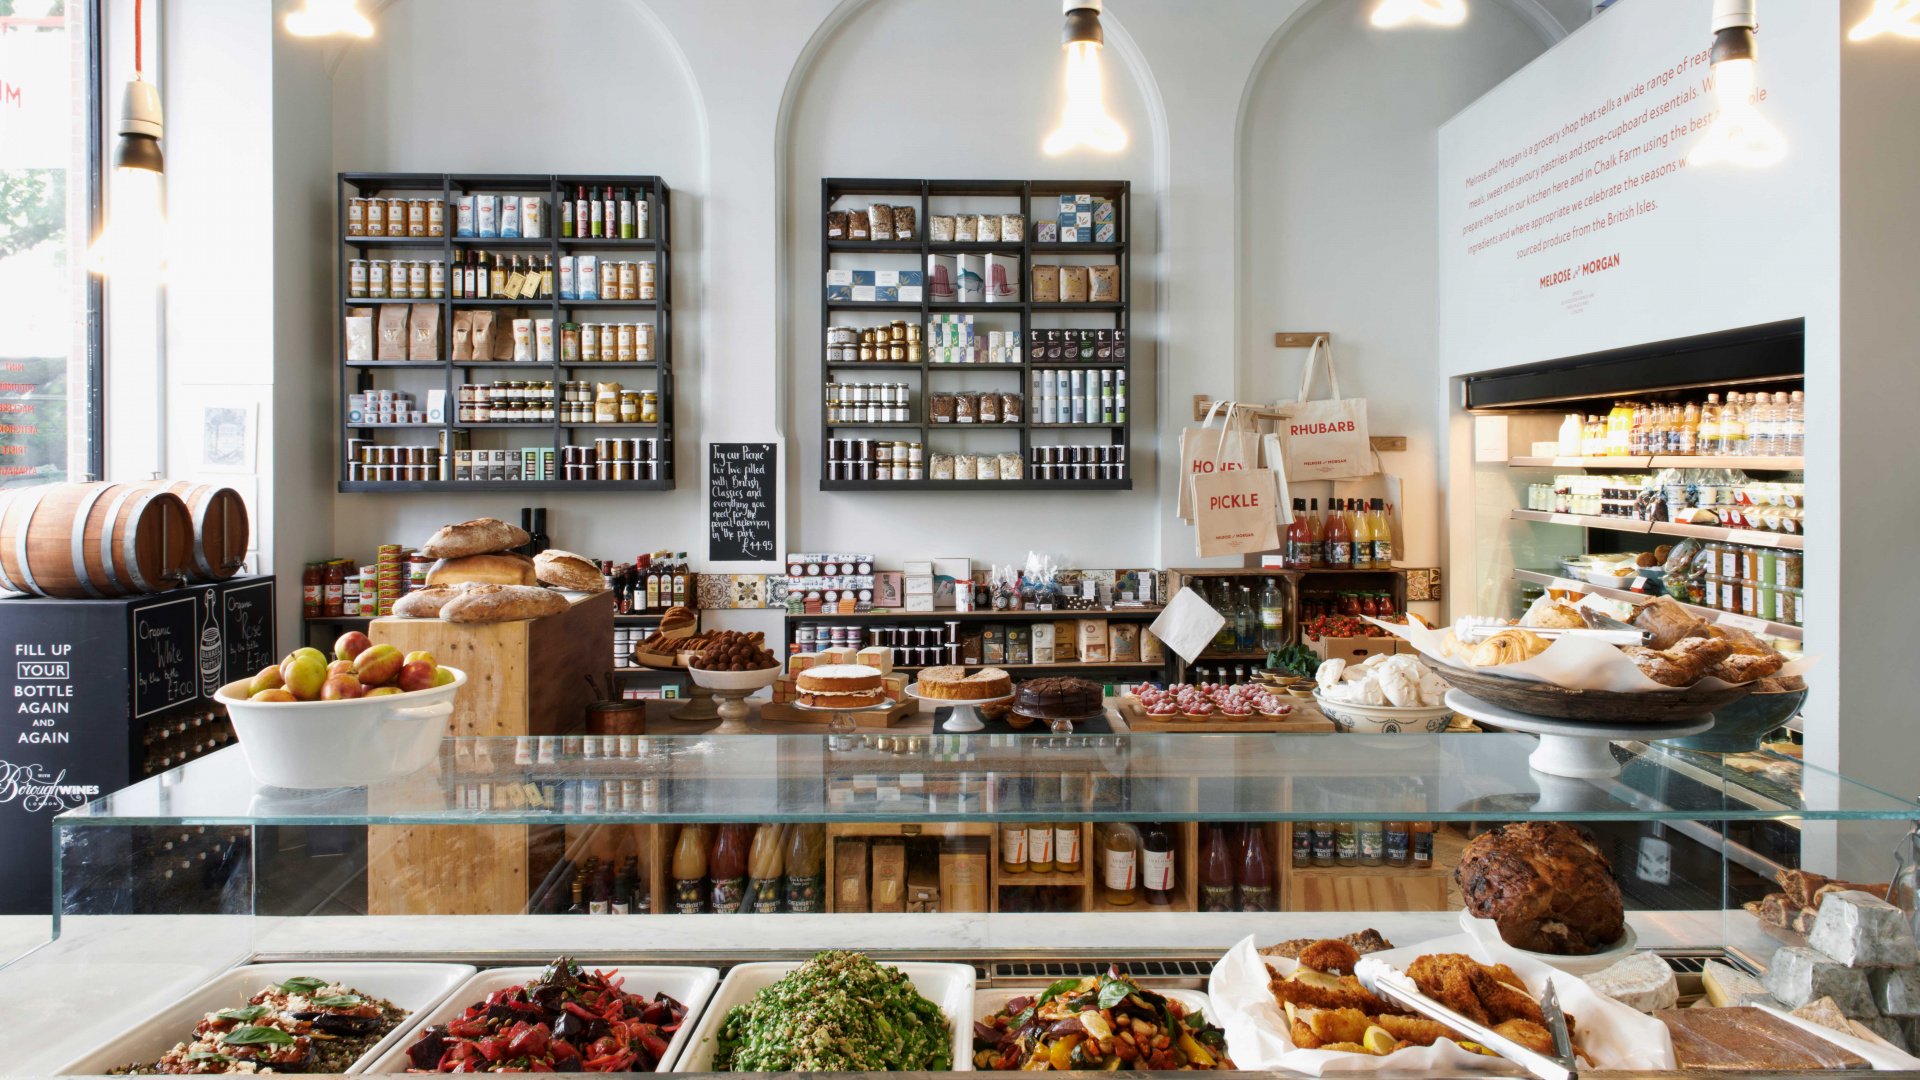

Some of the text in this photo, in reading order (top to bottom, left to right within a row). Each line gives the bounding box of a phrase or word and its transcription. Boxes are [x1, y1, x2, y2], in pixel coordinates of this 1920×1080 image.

[1465, 171, 1487, 189] Melrose
[1488, 162, 1498, 177] and
[1499, 152, 1521, 171] Morgan
[1523, 148, 1528, 158] is
[1529, 146, 1533, 155] a
[1534, 131, 1560, 155] grocery
[1562, 121, 1579, 137] shop
[1580, 110, 1597, 127] that
[1597, 97, 1615, 118] sells
[1617, 96, 1622, 107] a
[1624, 83, 1645, 103] wide
[1647, 68, 1674, 92] range
[1677, 56, 1688, 75] of
[1487, 185, 1503, 201] sweet
[1504, 177, 1514, 192] and
[1516, 167, 1539, 186] savoury
[1541, 153, 1568, 176] pastries
[1569, 142, 1583, 160] and
[1584, 109, 1648, 152] store-cupboard
[1650, 86, 1700, 120] essentials.
[1463, 112, 1712, 237] prepare the food in our kitchen here and in Chalk Farm using the best
[1468, 161, 1676, 255] ingredients and where appropriate we celebrate the seasons
[1517, 199, 1658, 259] sourced produce from the British Isles.
[1540, 268, 1571, 289] MELROSE
[1582, 252, 1620, 276] MORGAN
[1290, 420, 1355, 436] RHUBARB
[712, 444, 765, 467] Try our Picnic
[726, 461, 742, 474] Two
[744, 463, 766, 480] filled
[712, 475, 760, 490] with British
[712, 486, 762, 499] Classics and
[713, 498, 766, 515] everything you
[1210, 493, 1258, 511] PICKLE
[711, 517, 770, 532] perfect afternoon
[713, 508, 757, 524] need for the
[712, 531, 721, 542] in
[723, 528, 734, 541] the
[241, 611, 264, 640] Rosé
[15, 644, 72, 656] FILL UP
[157, 640, 183, 668] White
[21, 664, 66, 677] YOUR
[14, 685, 73, 697] BOTTLE
[139, 672, 148, 695] by
[17, 702, 69, 714] AGAIN
[32, 718, 55, 727] AND
[17, 732, 69, 744] AGAIN
